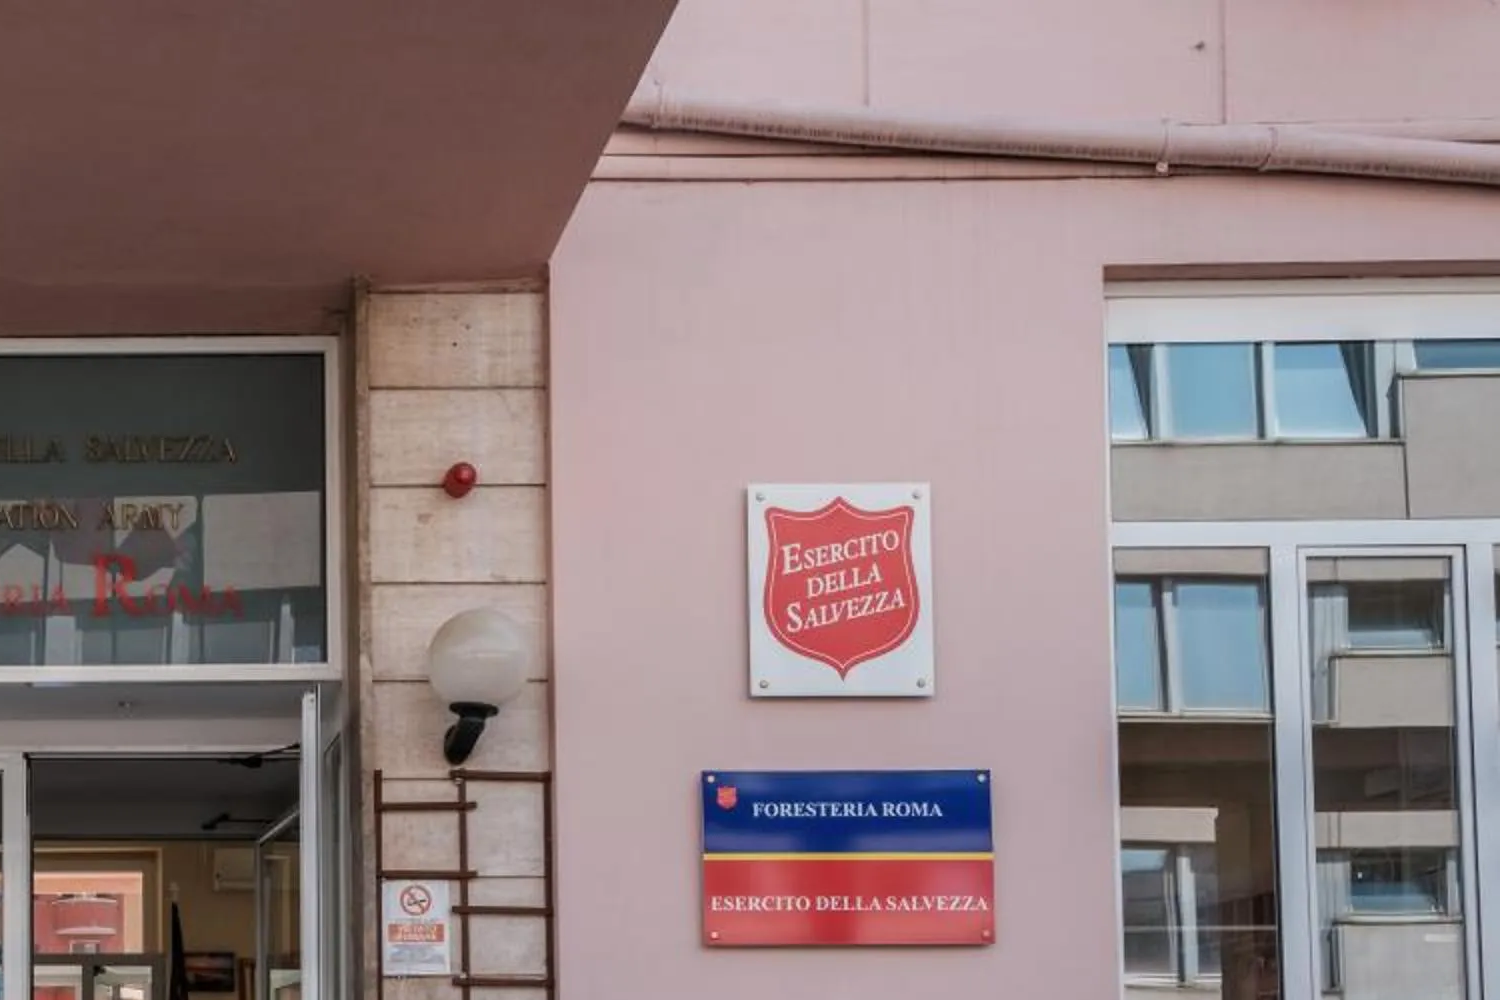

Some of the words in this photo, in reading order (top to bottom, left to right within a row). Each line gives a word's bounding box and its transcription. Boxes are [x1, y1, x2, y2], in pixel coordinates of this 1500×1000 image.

[84, 434, 238, 465] SALVEZZA
[98, 503, 184, 530] ARMY
[781, 529, 900, 575] ESERCITO
[92, 552, 245, 618] ROMA
[807, 562, 883, 599] DELLA
[786, 588, 906, 633] SALVEZZA
[752, 801, 878, 818] FORESTERIA
[882, 801, 943, 818] ROMA
[711, 895, 811, 912] ESERCITO
[815, 895, 881, 912] DELLA
[885, 895, 989, 912] SALVEZZA
